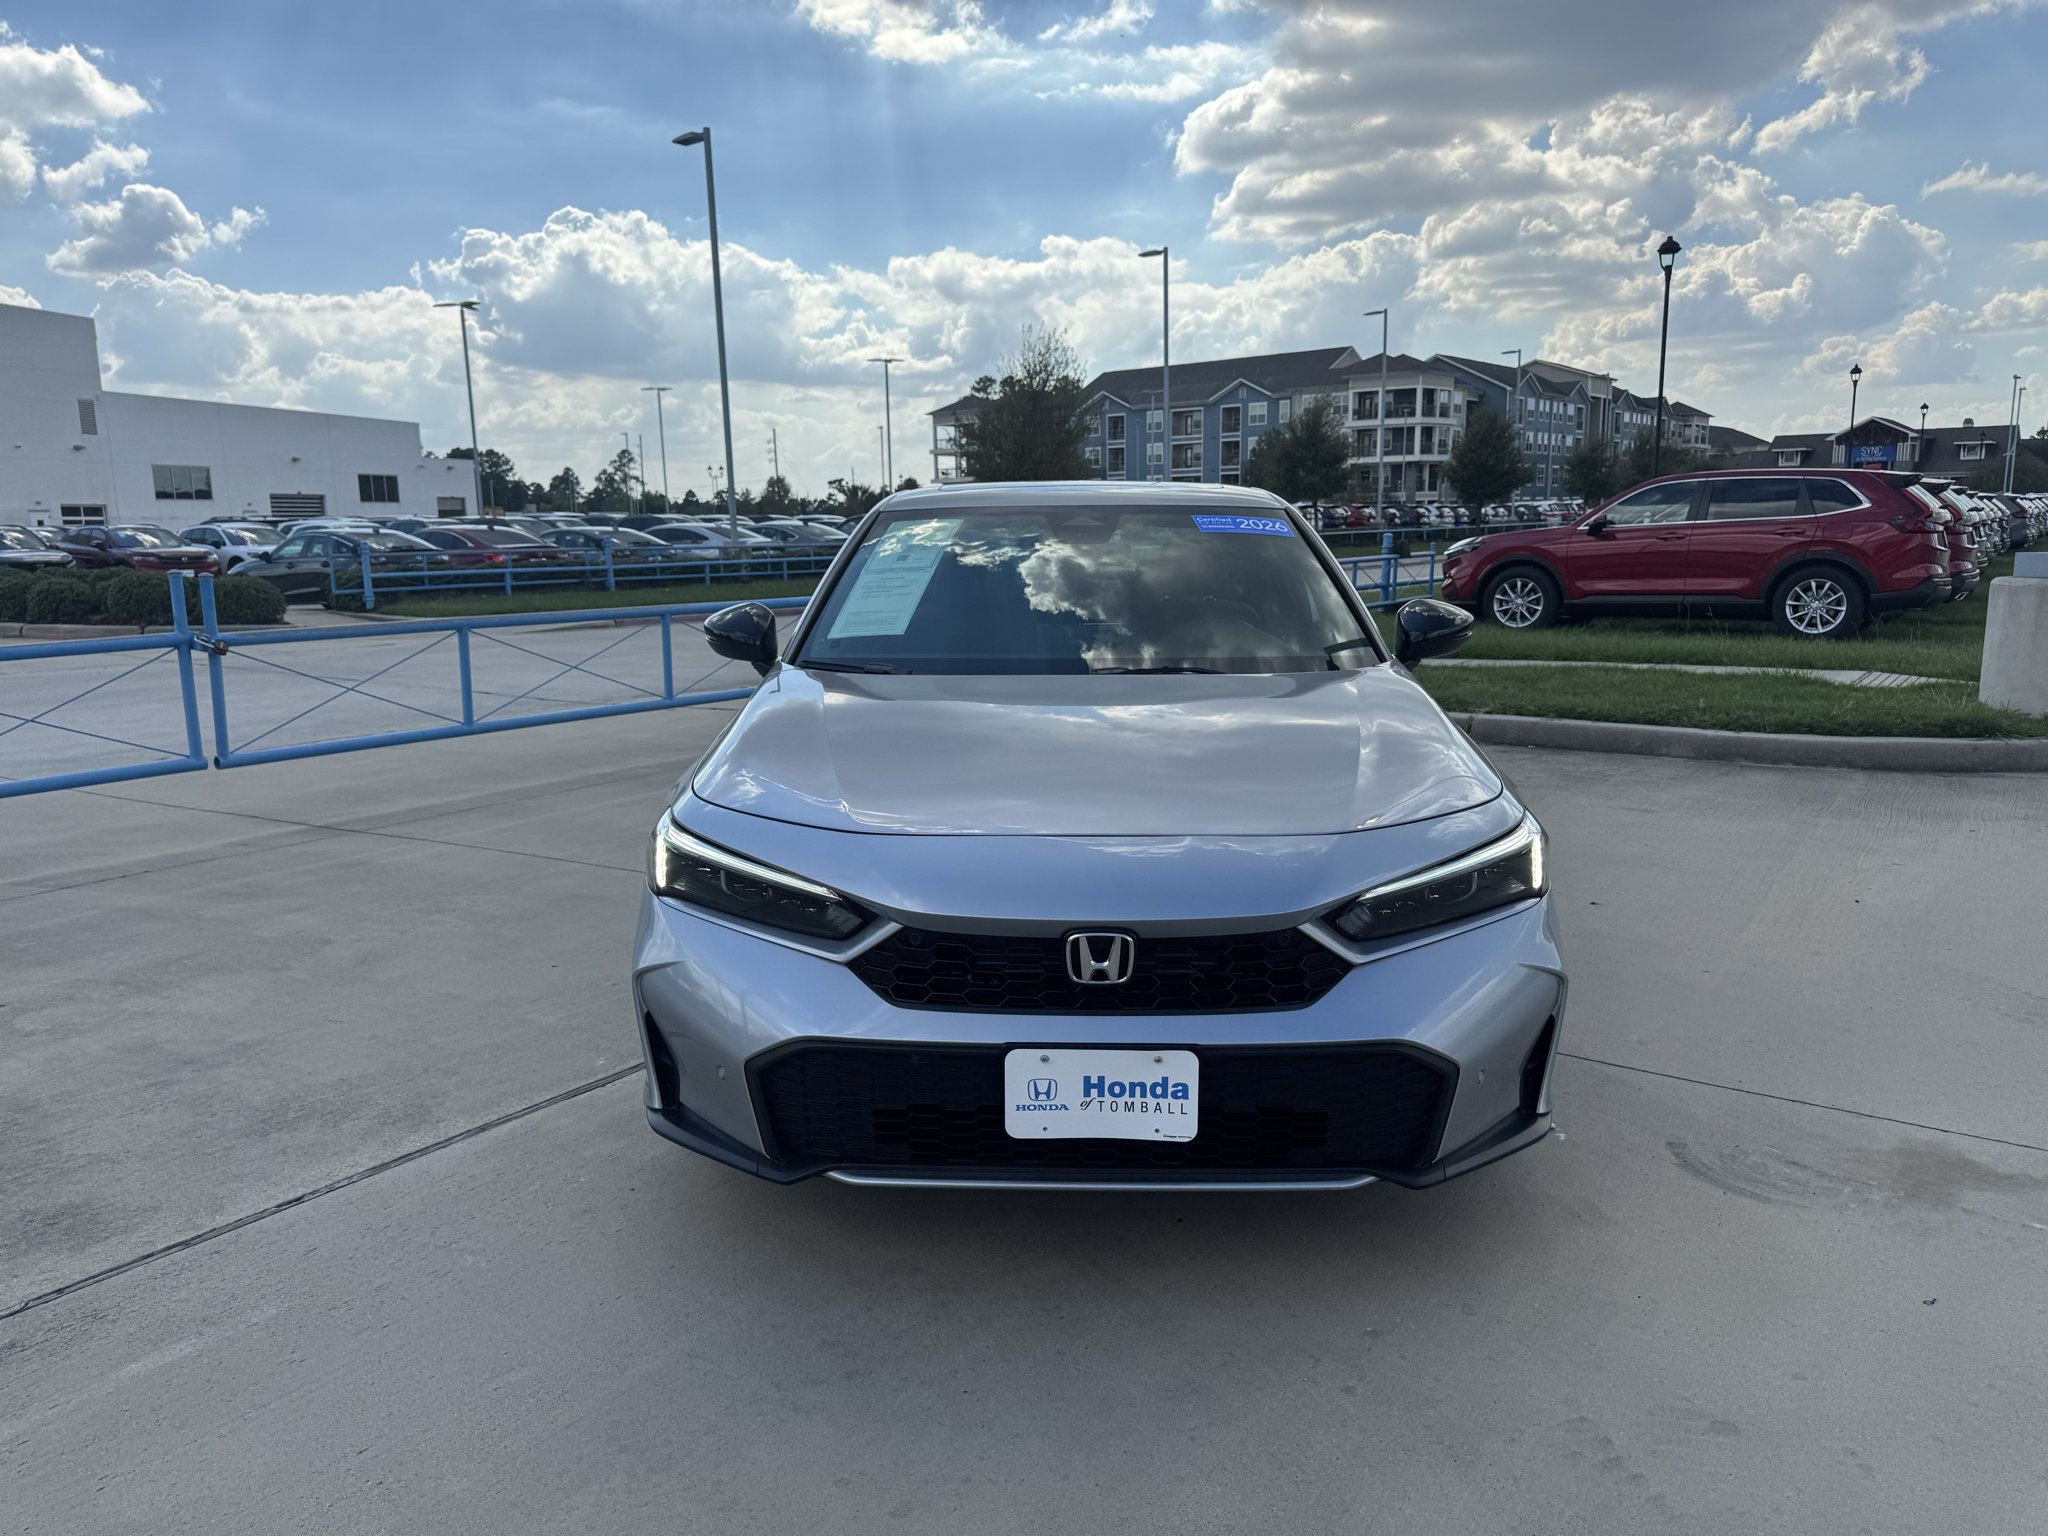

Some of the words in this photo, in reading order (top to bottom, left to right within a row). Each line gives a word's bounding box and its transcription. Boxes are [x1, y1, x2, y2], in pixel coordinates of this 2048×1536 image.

[1860, 446, 1883, 457] SYNC
[1236, 518, 1288, 532] 2026
[1083, 1075, 1189, 1100] Honda
[1015, 1103, 1069, 1112] HONDA
[1080, 1098, 1096, 1110] of
[1097, 1100, 1188, 1115] TOMBALL
